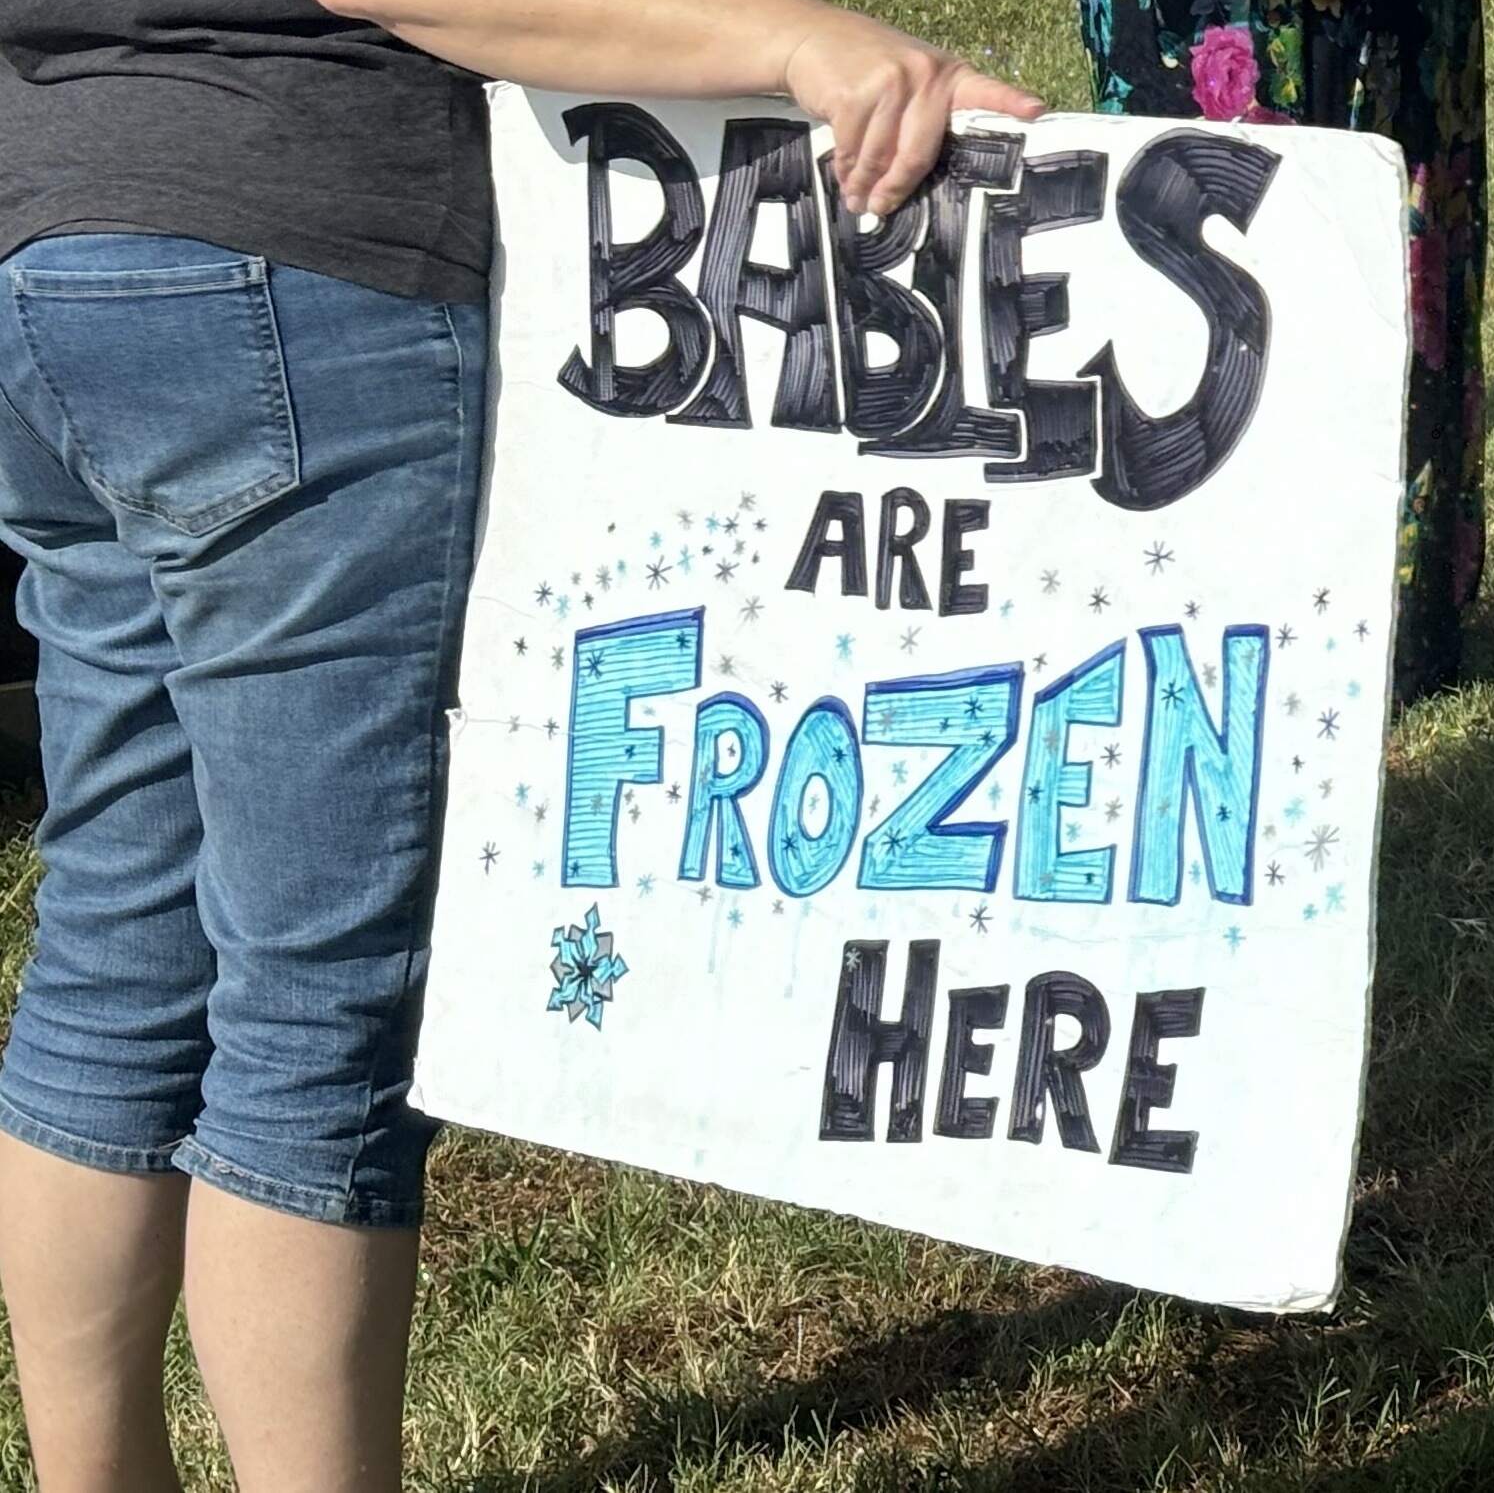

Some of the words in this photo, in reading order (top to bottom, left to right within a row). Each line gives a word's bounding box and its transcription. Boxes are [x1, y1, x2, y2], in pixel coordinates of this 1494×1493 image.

[557, 103, 1282, 512] BABIES
[785, 487, 990, 616] ARE
[561, 606, 1270, 905] FROZEN
[818, 939, 1206, 1173] HERE
